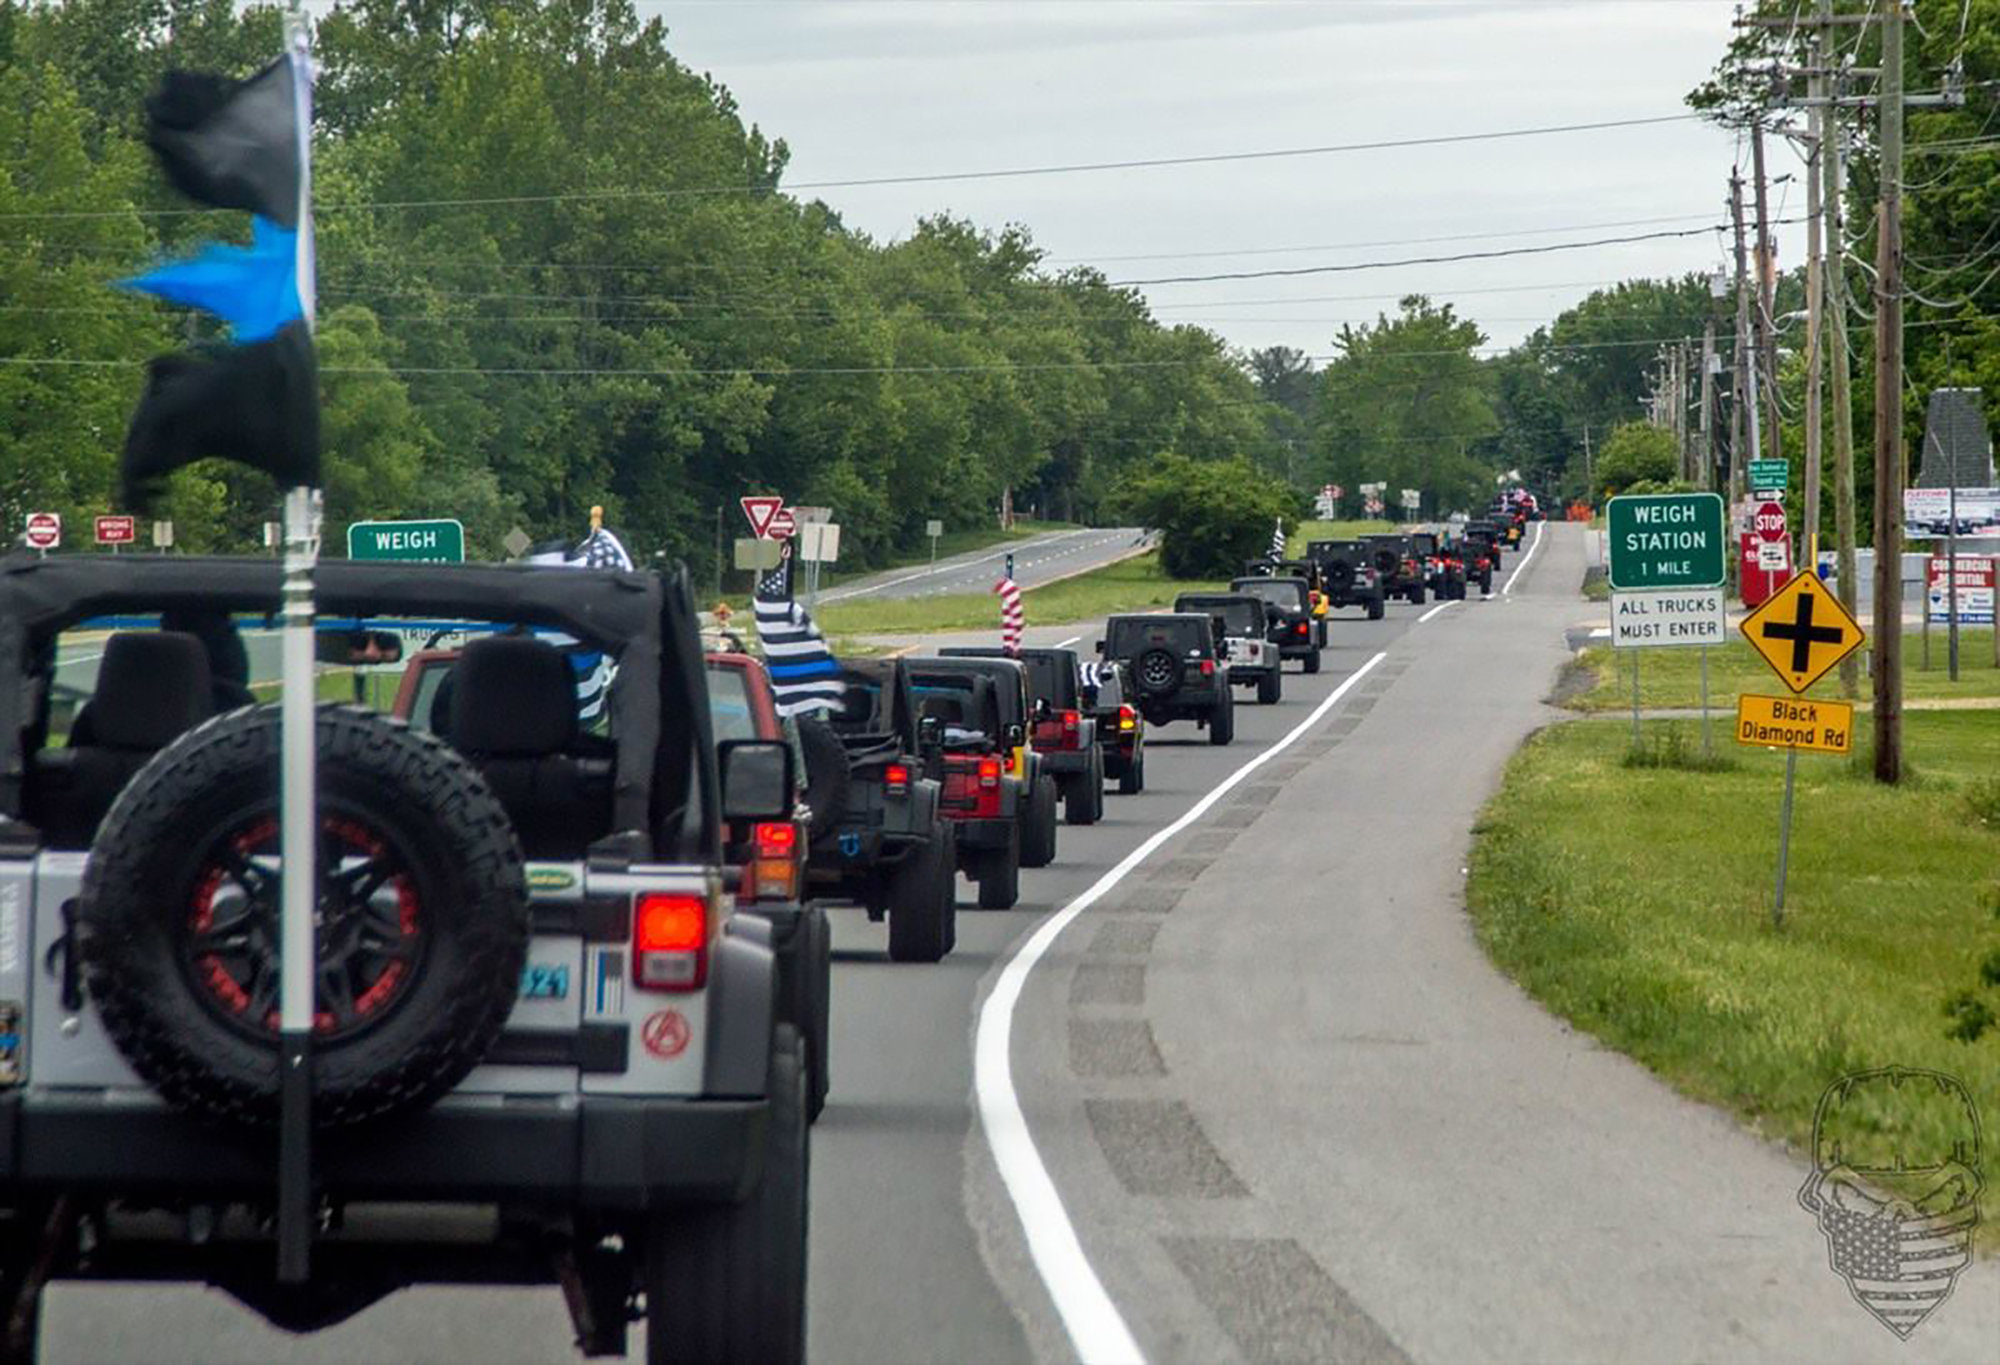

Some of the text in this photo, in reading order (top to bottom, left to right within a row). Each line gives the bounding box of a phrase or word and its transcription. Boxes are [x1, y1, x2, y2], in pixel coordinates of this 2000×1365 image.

[1634, 505, 1696, 524] WEIGH
[1757, 514, 1784, 531] STOP
[376, 530, 437, 550] WEIGH
[1626, 531, 1706, 551] STATION
[1641, 561, 1692, 576] 1 MILE
[1619, 598, 1717, 615] ALL TRUCKS
[1620, 621, 1717, 638] MUST ENTER
[1772, 701, 1817, 722] Black
[1741, 720, 1845, 748] Diamond Rd
